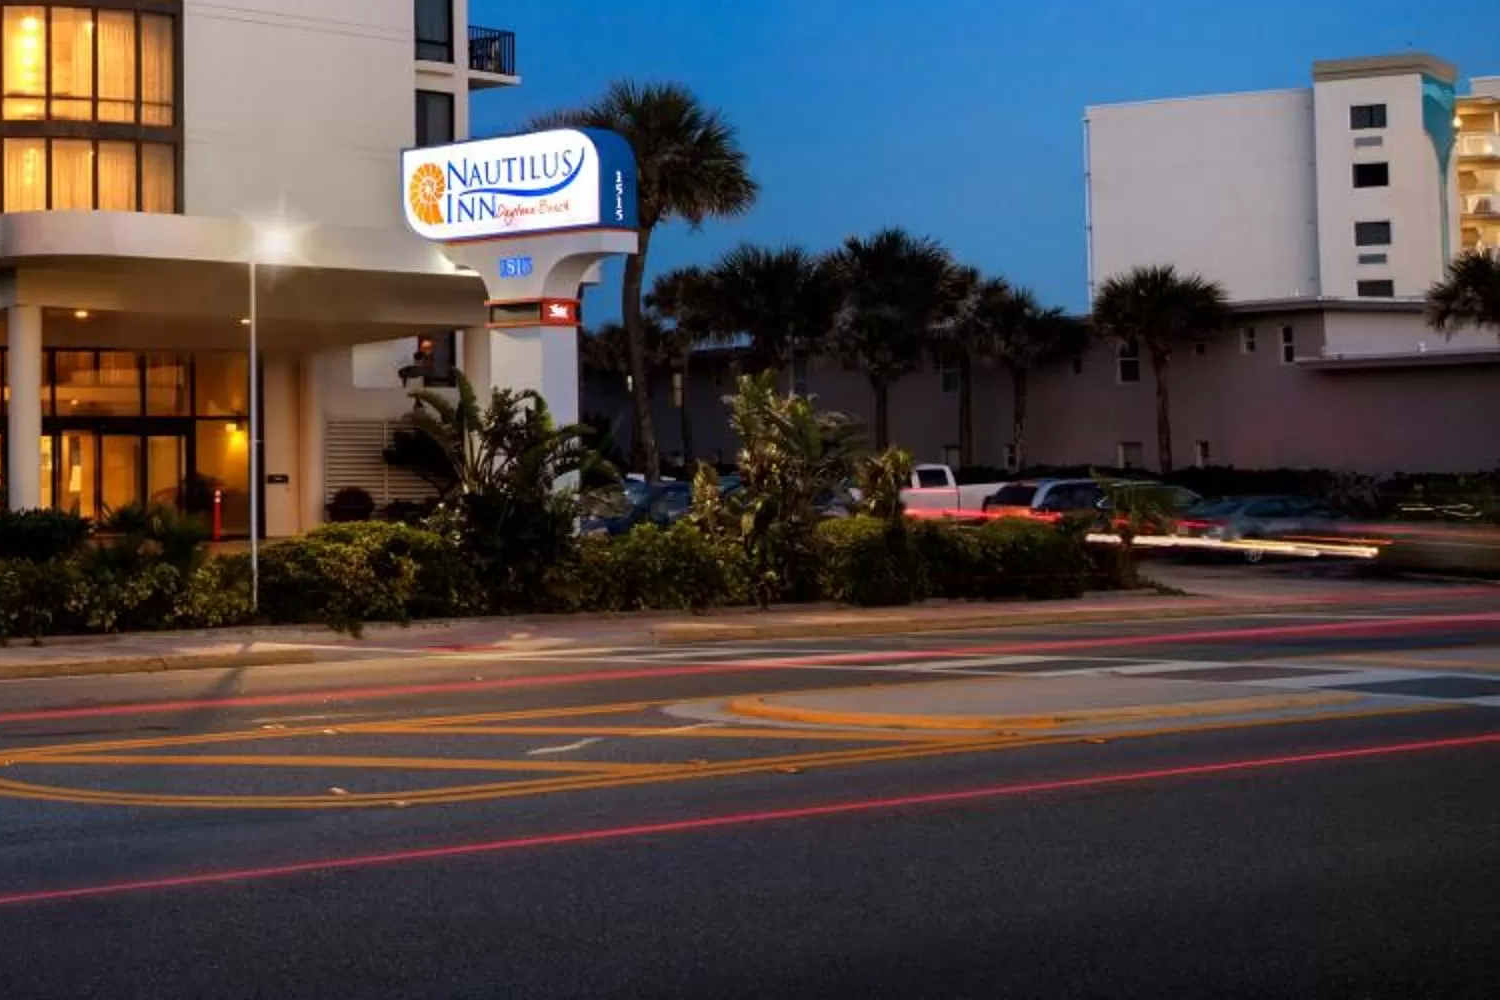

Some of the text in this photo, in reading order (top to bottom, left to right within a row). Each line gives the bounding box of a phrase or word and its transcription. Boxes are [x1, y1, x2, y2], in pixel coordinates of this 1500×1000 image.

[447, 150, 573, 190] NAUTILUS
[446, 194, 496, 224] INN
[614, 170, 624, 221] 1515
